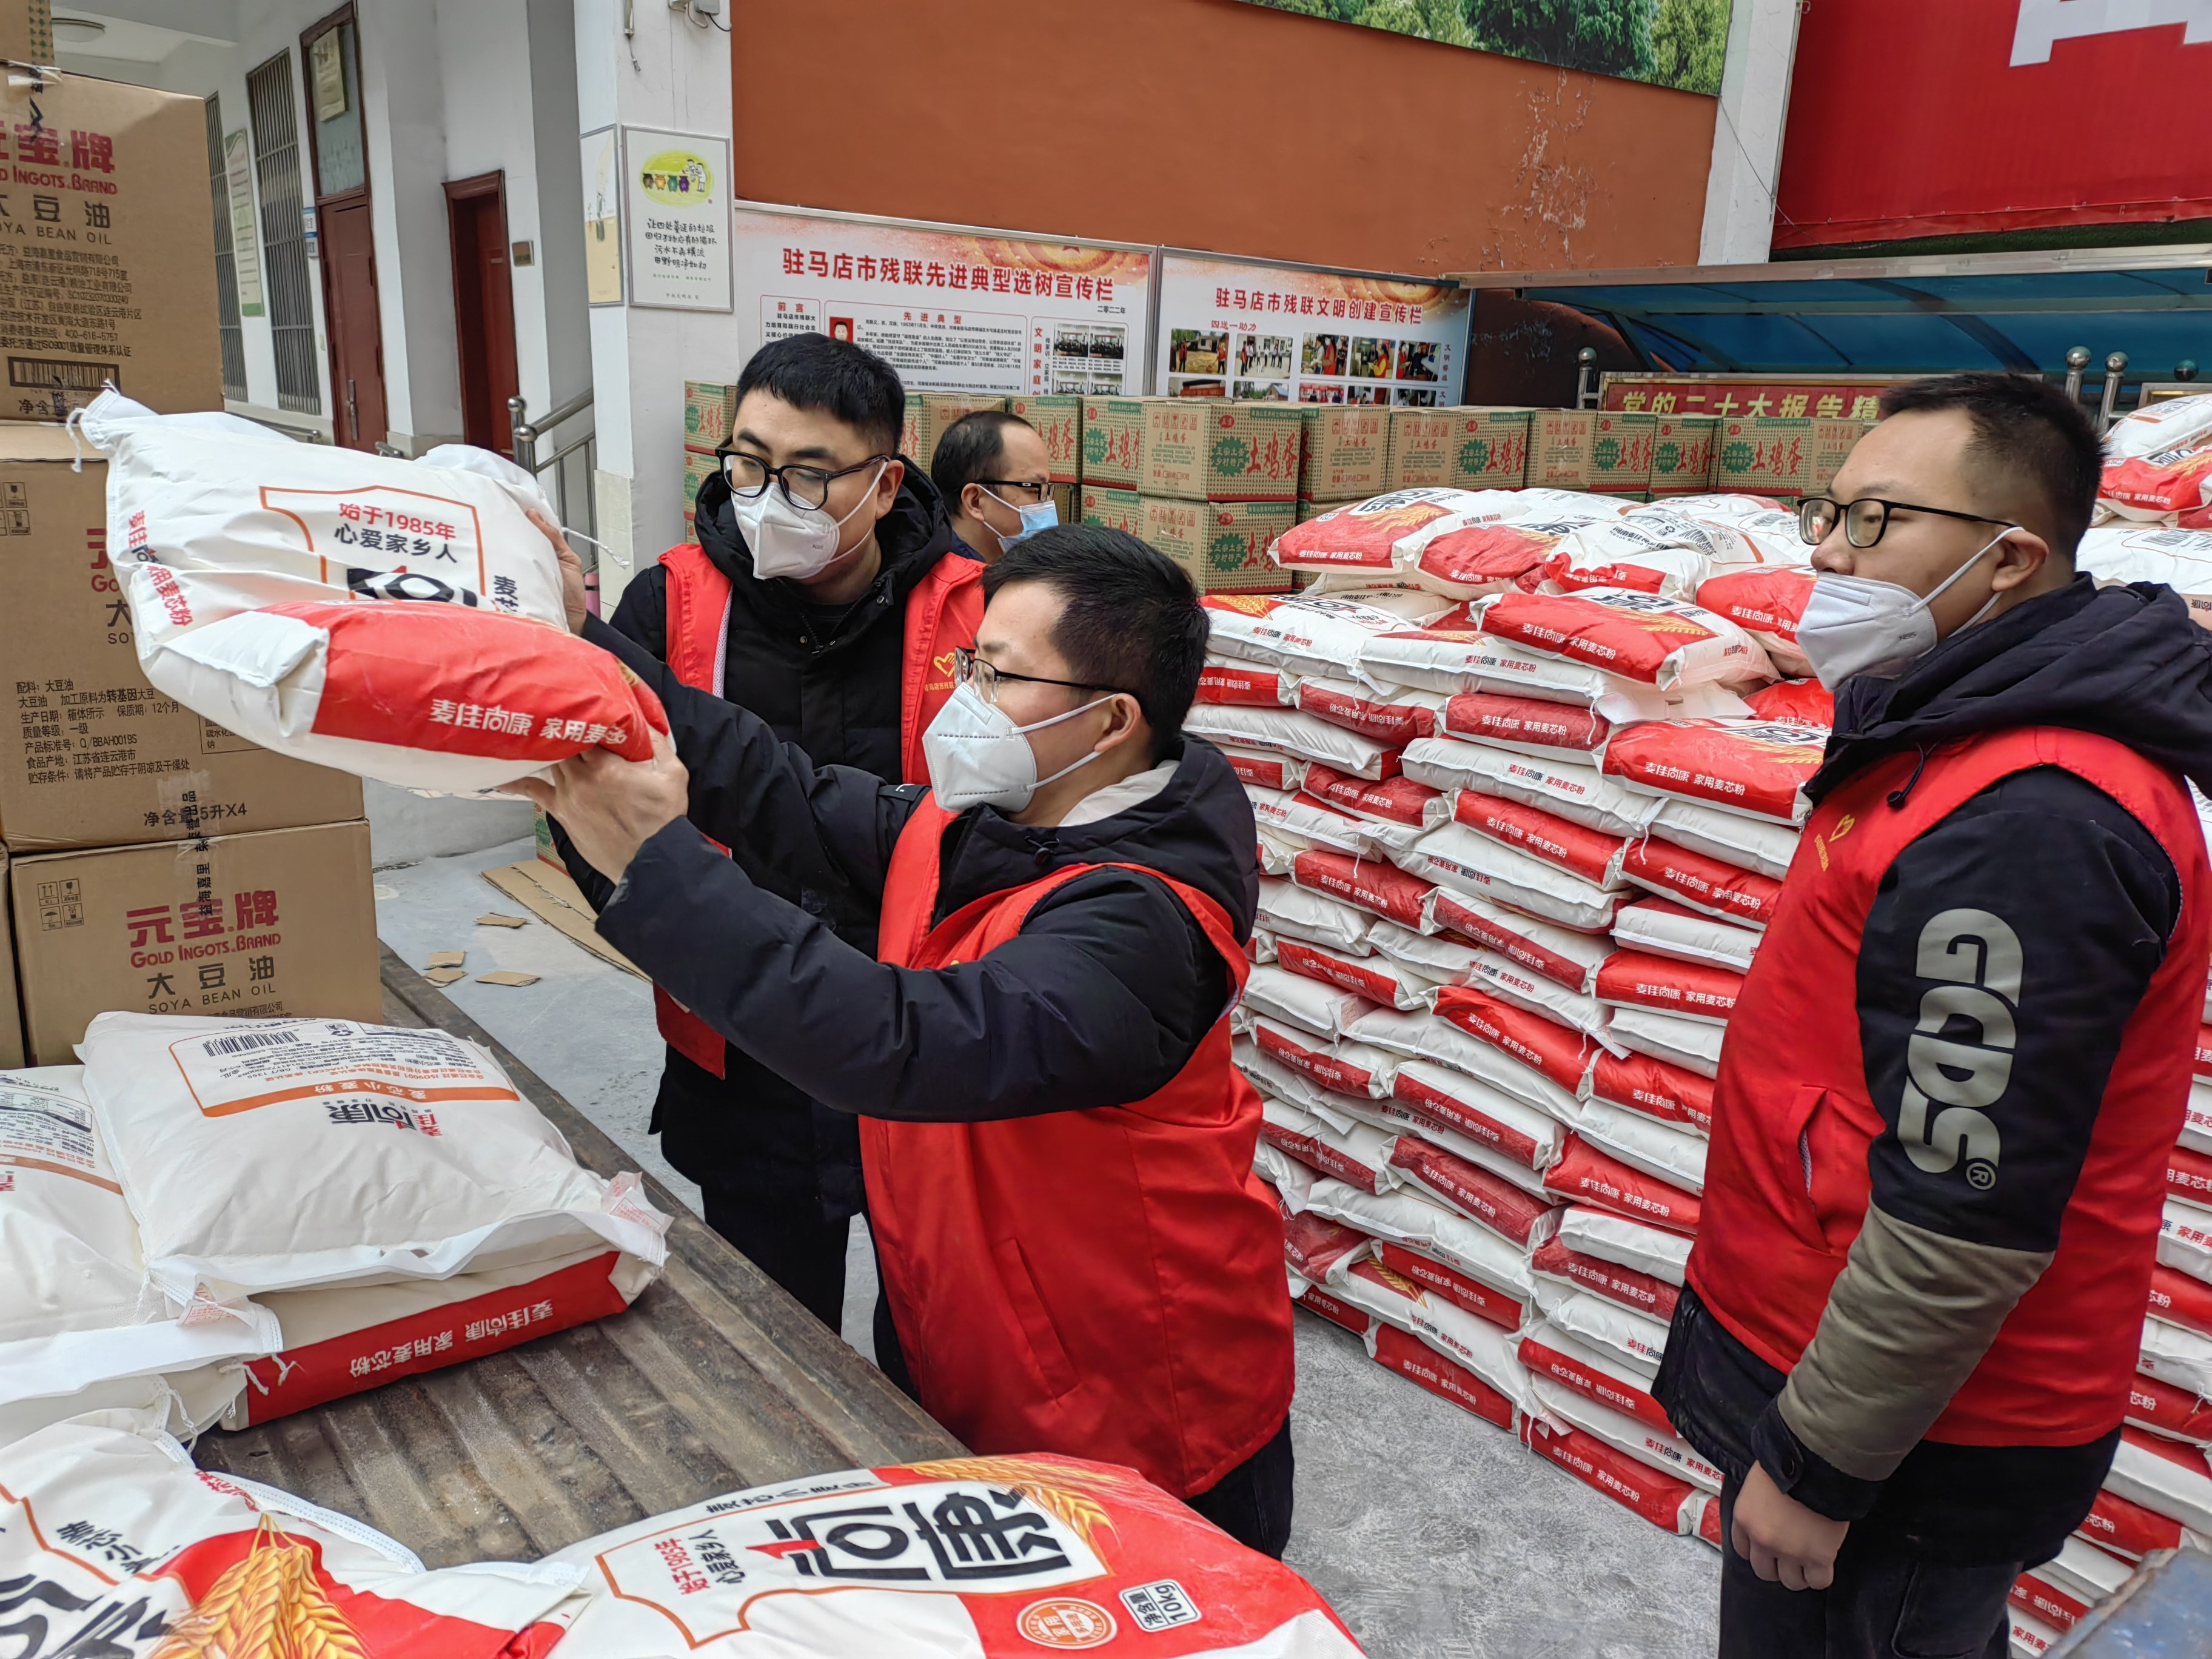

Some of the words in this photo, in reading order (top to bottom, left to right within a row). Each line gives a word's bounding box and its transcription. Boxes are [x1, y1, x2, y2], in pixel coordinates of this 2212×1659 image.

[13, 166, 65, 189] INGOTS
[72, 173, 118, 195] BRAND
[36, 226, 76, 241] BEAN
[87, 232, 112, 244] OIL
[654, 244, 705, 257] 污水不再横流
[654, 256, 706, 270] 田野明净如初
[782, 247, 1114, 301] 驻马店市残联先进典型选树宣传栏
[777, 301, 804, 313] 前言
[903, 312, 962, 324] 先进典型
[1216, 286, 1423, 326] 驻马店市残联文明创建宣传栏
[1211, 320, 1257, 332] 四送一助力
[1247, 431, 1298, 480] 土鸡蛋
[1486, 431, 1525, 475] 土鸡蛋
[1617, 432, 1652, 472] 土鸡蛋
[1751, 436, 1803, 477] 土鸡蛋
[339, 503, 456, 540] 始于1985年
[334, 523, 457, 563] 心爱家乡人
[1299, 549, 1328, 559] 麦佳尚康
[1330, 551, 1363, 560] 家用麦芯粉
[1731, 606, 1775, 624] 麦佳尚康
[1252, 626, 1282, 639] 麦佳尚康
[1523, 622, 1565, 645] 麦佳尚康
[1569, 635, 1617, 661] 家用麦芯粉
[1464, 655, 1497, 667] 麦佳尚康
[1500, 659, 1537, 674] 家用麦芯粉
[18, 695, 47, 708] 大豆油
[61, 688, 155, 706] 加工原料为转基因大豆
[45, 680, 74, 692] 大豆油
[67, 708, 104, 721] 箱体所示
[152, 702, 179, 714] 12个月
[428, 699, 534, 736] 麦佳尚康
[1481, 714, 1521, 729] 麦佳尚康
[1524, 720, 1567, 736] 家用麦芯粉
[69, 722, 88, 734] 一级
[73, 749, 136, 765] 江苏省连云港市
[1507, 763, 1544, 782] 麦佳尚康
[1545, 776, 1586, 795] 家用麦芯粉
[1645, 761, 1689, 783] 麦佳尚康
[1694, 773, 1746, 797] 家用麦芯粉
[1259, 802, 1287, 818] 家用麦芯粉
[1330, 782, 1359, 799] 麦佳尚康
[1361, 792, 1393, 809] 家用麦芯粉
[1486, 816, 1524, 840] 麦佳尚康
[1526, 833, 1568, 859] 家用麦芯粉
[1427, 855, 1458, 873] 家用麦芯粉
[1460, 866, 1491, 885] 麦佳尚康
[196, 863, 213, 916] 益海嘉里
[1320, 874, 1352, 894] 麦佳尚康
[1353, 886, 1389, 908] 家用麦芯粉
[1664, 866, 1710, 894] 麦佳尚康
[1712, 887, 1761, 910] 家用麦芯粉
[127, 890, 279, 948] 元宝牌
[130, 950, 174, 968] GOLD
[179, 942, 229, 960] INGOTS
[236, 933, 281, 951] BRAND
[1507, 943, 1546, 971] 麦佳尚康
[147, 956, 275, 999] 大豆油
[1469, 960, 1499, 979] 麦佳尚康
[1499, 972, 1535, 994] 家用麦芯粉
[149, 999, 191, 1014] SOYA
[202, 988, 241, 1005] BEAN
[251, 983, 276, 995] OIL
[1635, 983, 1681, 1000] 麦佳尚康
[1686, 990, 1737, 1008] 家用麦芯粉
[1467, 1012, 1500, 1040] 麦佳尚康
[1502, 1035, 1543, 1065] 家用麦芯粉
[1897, 908, 2023, 1174] GCDS
[314, 1080, 427, 1100] 麦芯小麦粉
[1631, 1089, 1676, 1110] 麦佳尚康
[1381, 1104, 1411, 1121] 麦佳尚康
[1412, 1116, 1445, 1135] 家用麦芯粉
[1425, 1098, 1463, 1123] 家用麦芯粉
[1465, 1117, 1500, 1143] 麦佳尚康
[1421, 1162, 1455, 1192] 麦佳尚康
[1456, 1187, 1496, 1218] 家用麦芯粉
[1580, 1176, 1620, 1201] 麦佳尚康
[1623, 1193, 1671, 1218] 家用麦芯粉
[1567, 1261, 1609, 1285] 麦佳尚康
[1610, 1279, 1656, 1305] 家用麦芯粉
[1307, 1292, 1340, 1316] 家用麦芯粉
[465, 1299, 554, 1343] 麦佳尚康
[349, 1329, 454, 1379] 家用麦芯粉
[1440, 1332, 1473, 1359] 家用麦芯粉
[1403, 1359, 1438, 1384] 麦佳尚康
[1441, 1379, 1477, 1406] 家用麦芯粉
[1595, 1384, 1637, 1410] 麦佳尚康
[1644, 1435, 1683, 1463] 麦佳尚康
[1552, 1444, 1594, 1476] 麦佳尚康
[1596, 1468, 1640, 1503] 家用麦芯粉
[654, 1538, 711, 1595] 始于1985年
[688, 1529, 746, 1584] 心爱家乡人
[1129, 1590, 1163, 1626] 净含量
[1154, 1584, 1188, 1621] 10kg
